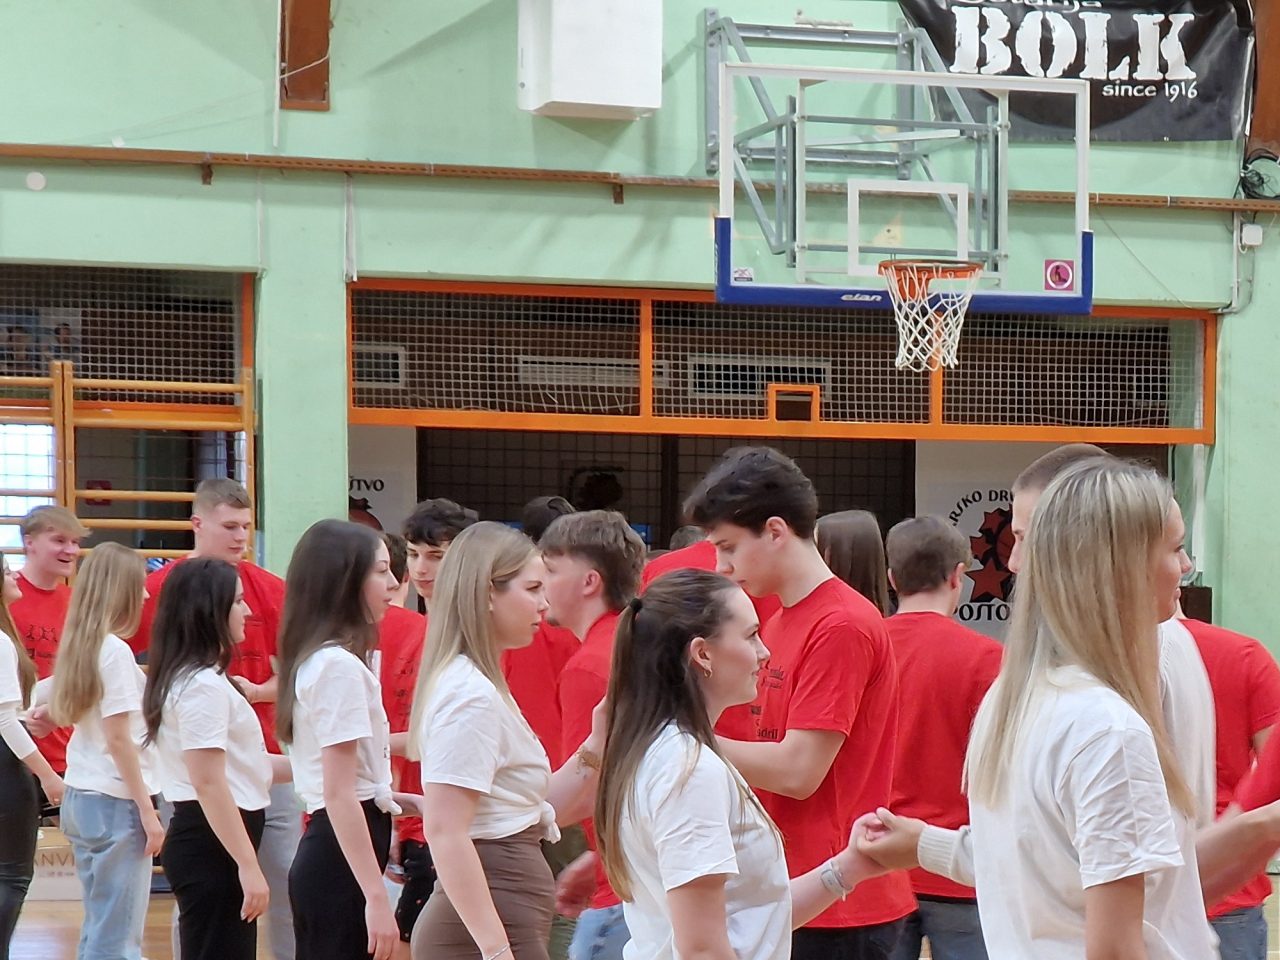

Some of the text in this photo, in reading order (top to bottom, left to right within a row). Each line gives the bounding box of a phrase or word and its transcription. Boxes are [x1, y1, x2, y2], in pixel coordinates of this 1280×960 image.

[950, 6, 1197, 80] BOLK
[1102, 80, 1198, 103] since 1916
[841, 293, 883, 302] elan
